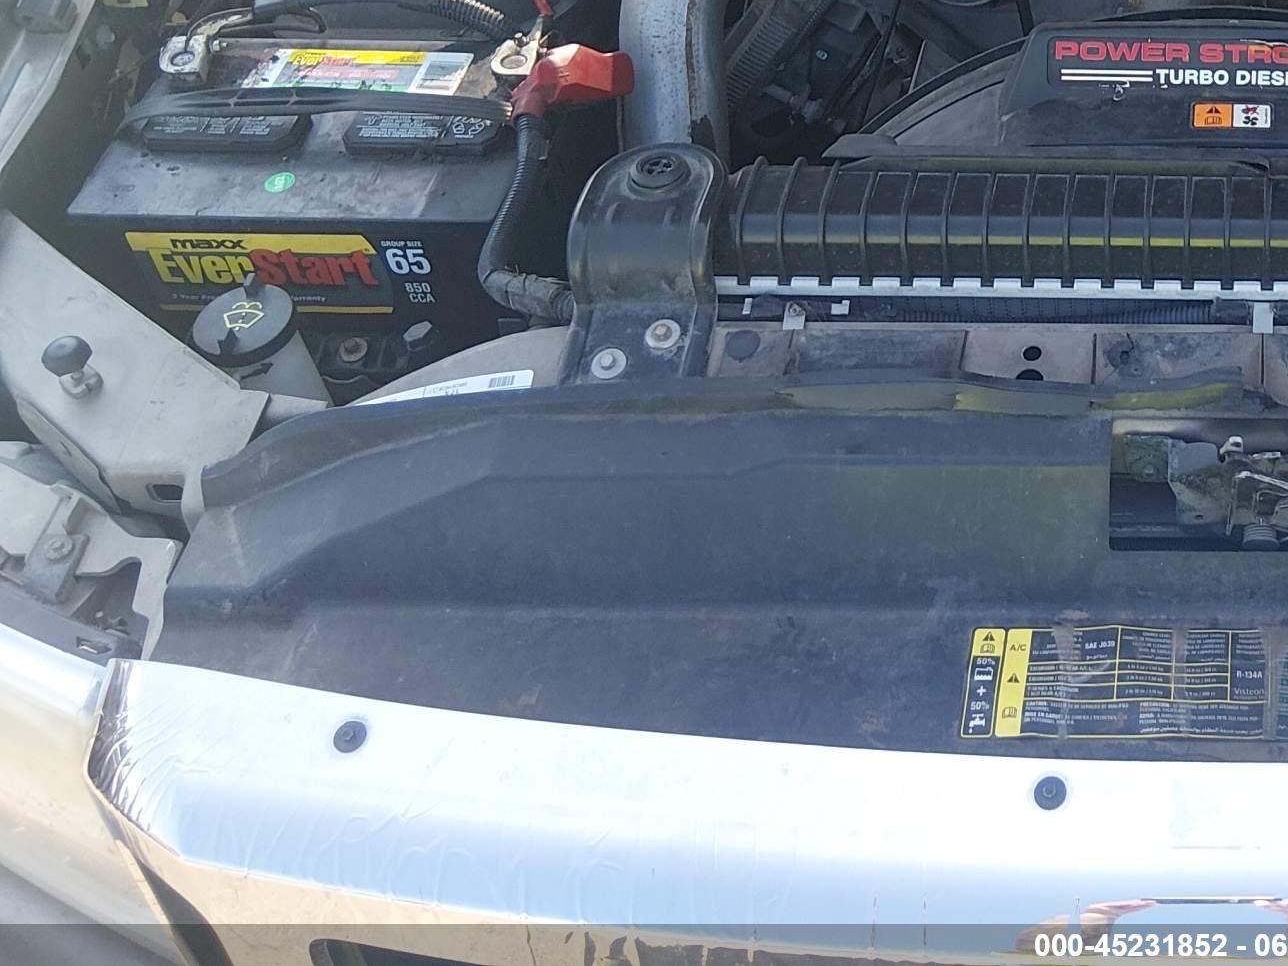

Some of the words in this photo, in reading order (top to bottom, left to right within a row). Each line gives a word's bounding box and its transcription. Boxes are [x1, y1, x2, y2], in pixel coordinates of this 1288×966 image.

[1055, 41, 1190, 62] POWER
[1155, 69, 1229, 85] TURBO
[170, 238, 247, 249] maxx
[148, 247, 378, 285] EverStart
[385, 248, 432, 274] 65
[404, 282, 431, 293] 850
[409, 293, 436, 303] CCA
[976, 658, 996, 666] 50%
[1236, 670, 1263, 679] R-134A
[970, 701, 990, 710] 50%
